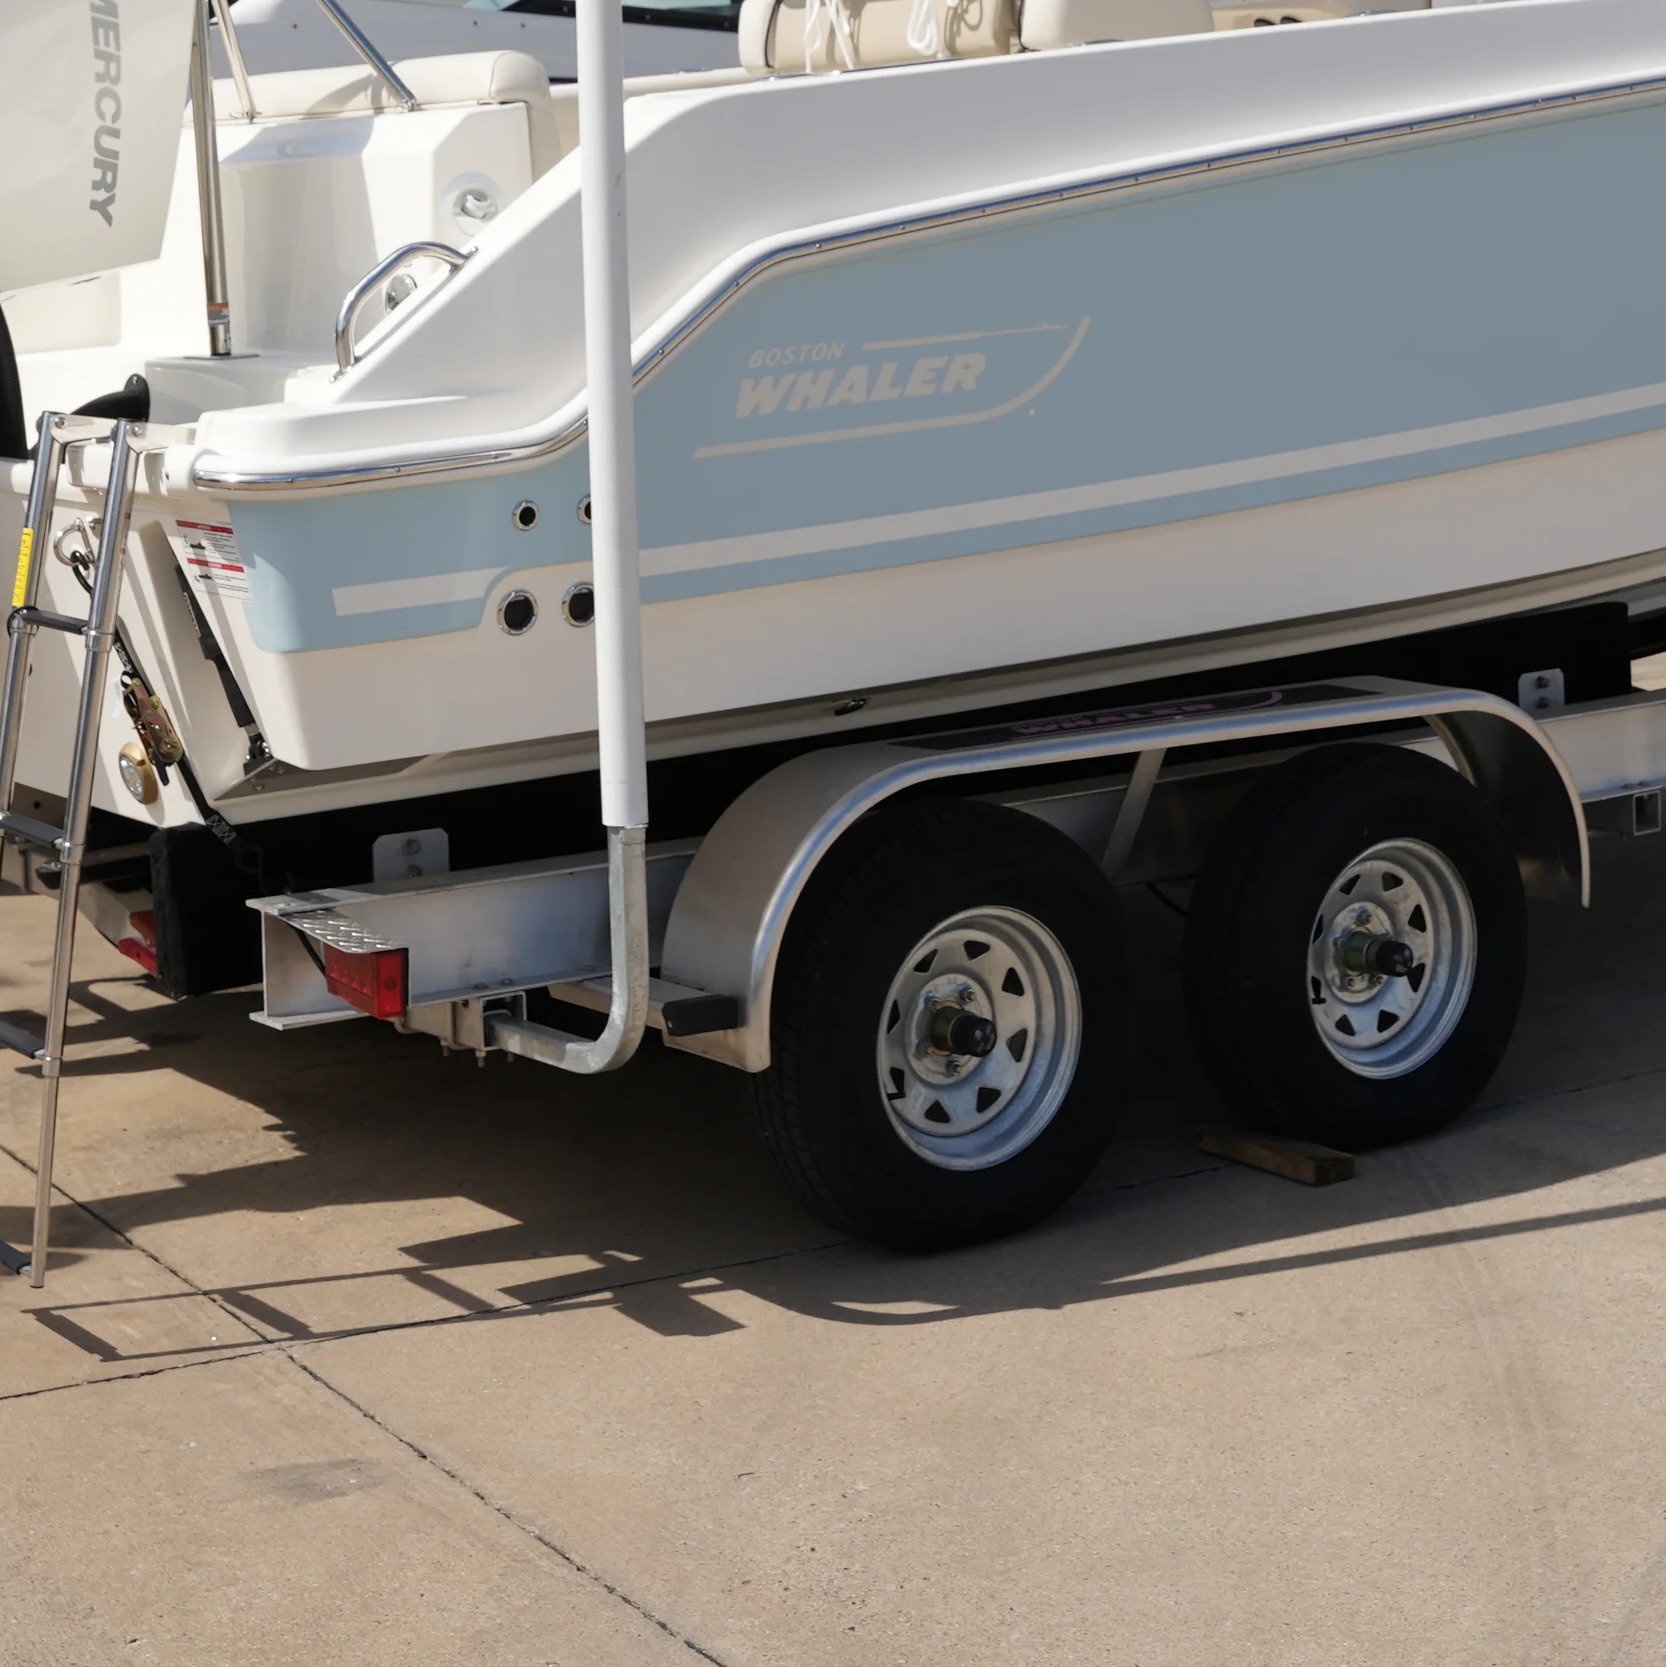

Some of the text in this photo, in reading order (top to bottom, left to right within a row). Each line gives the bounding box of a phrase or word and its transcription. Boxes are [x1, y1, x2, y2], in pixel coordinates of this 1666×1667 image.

[747, 340, 845, 369] BOSTON
[735, 352, 987, 419] WHALER
[1011, 703, 1216, 735] WHALER
